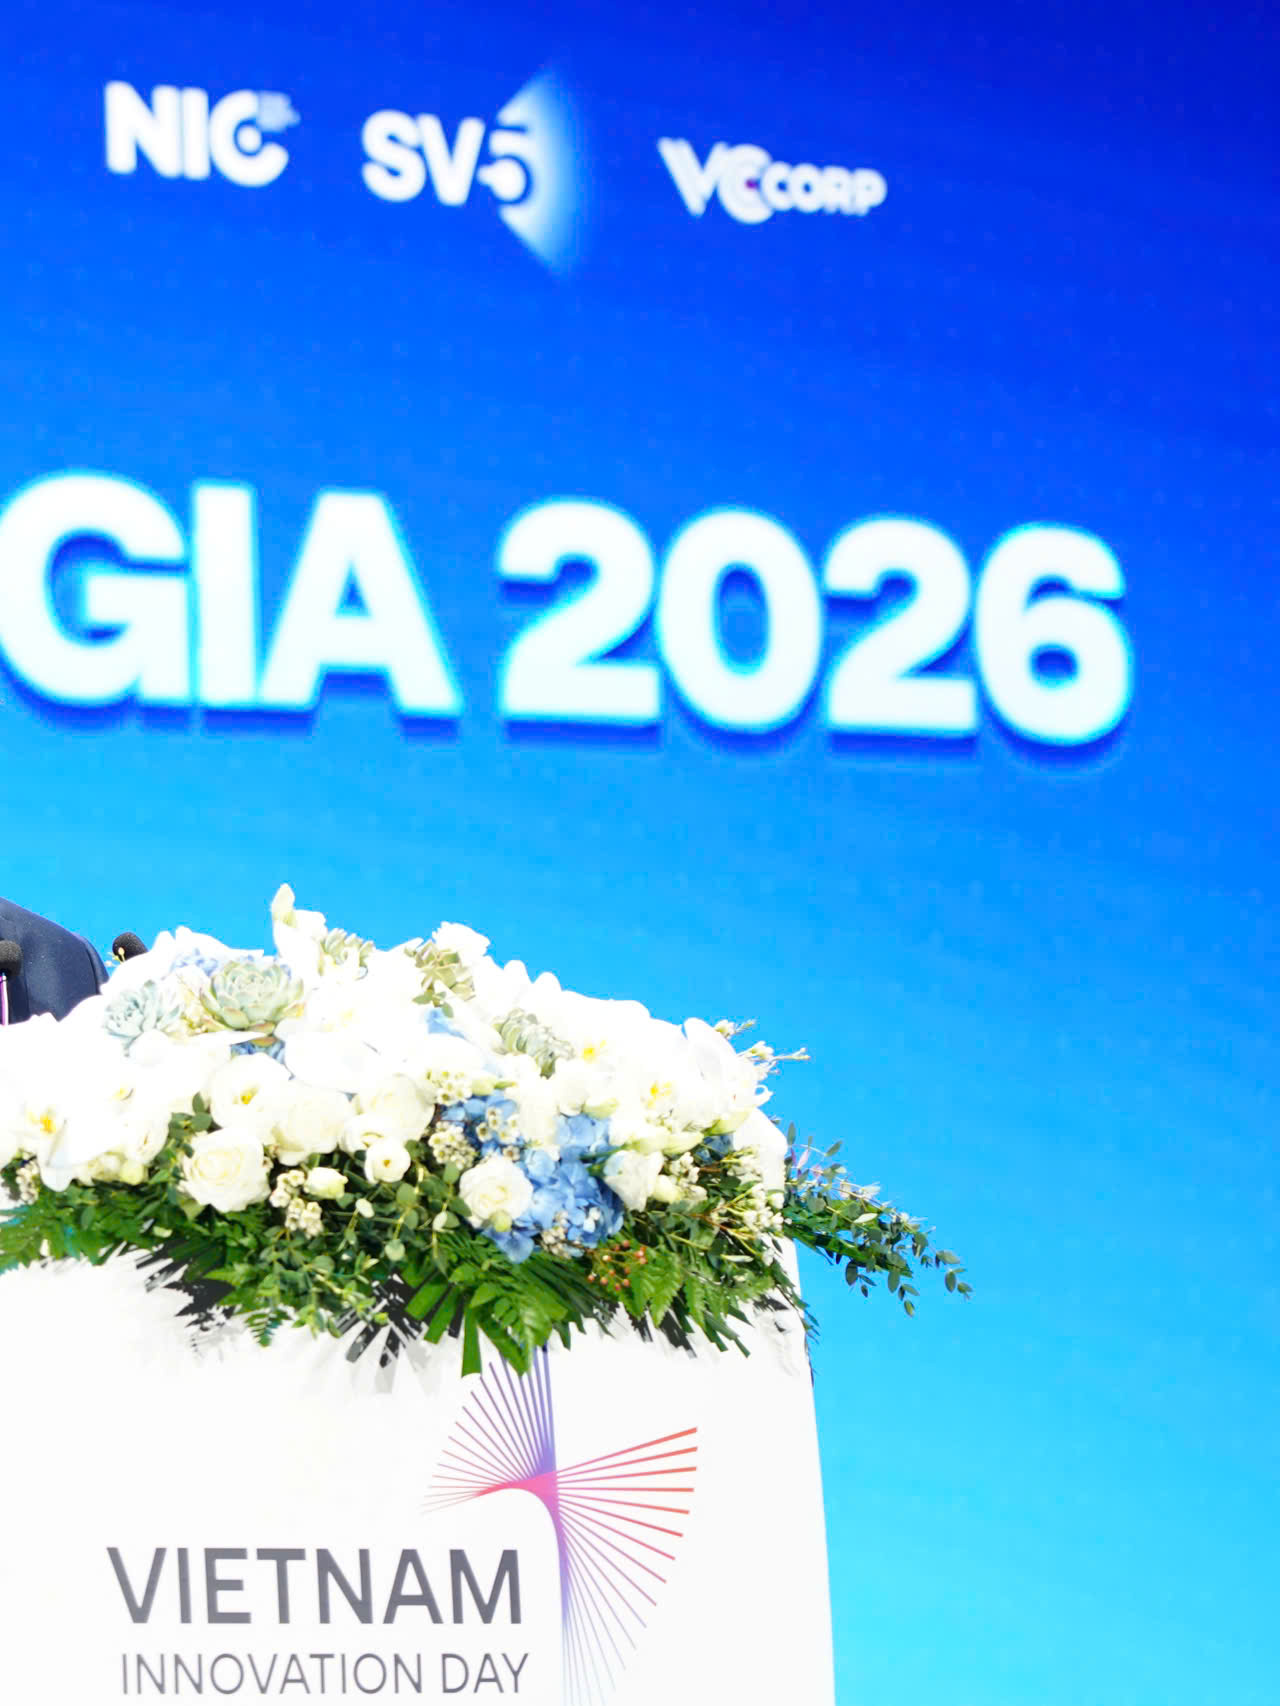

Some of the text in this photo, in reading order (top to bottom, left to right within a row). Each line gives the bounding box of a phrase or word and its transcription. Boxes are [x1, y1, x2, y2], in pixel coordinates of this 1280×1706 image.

[105, 80, 290, 187] NIC
[497, 500, 1132, 745] 2026
[106, 1547, 522, 1624] VIETNAM
[122, 1653, 529, 1695] INNOVATION DAY
